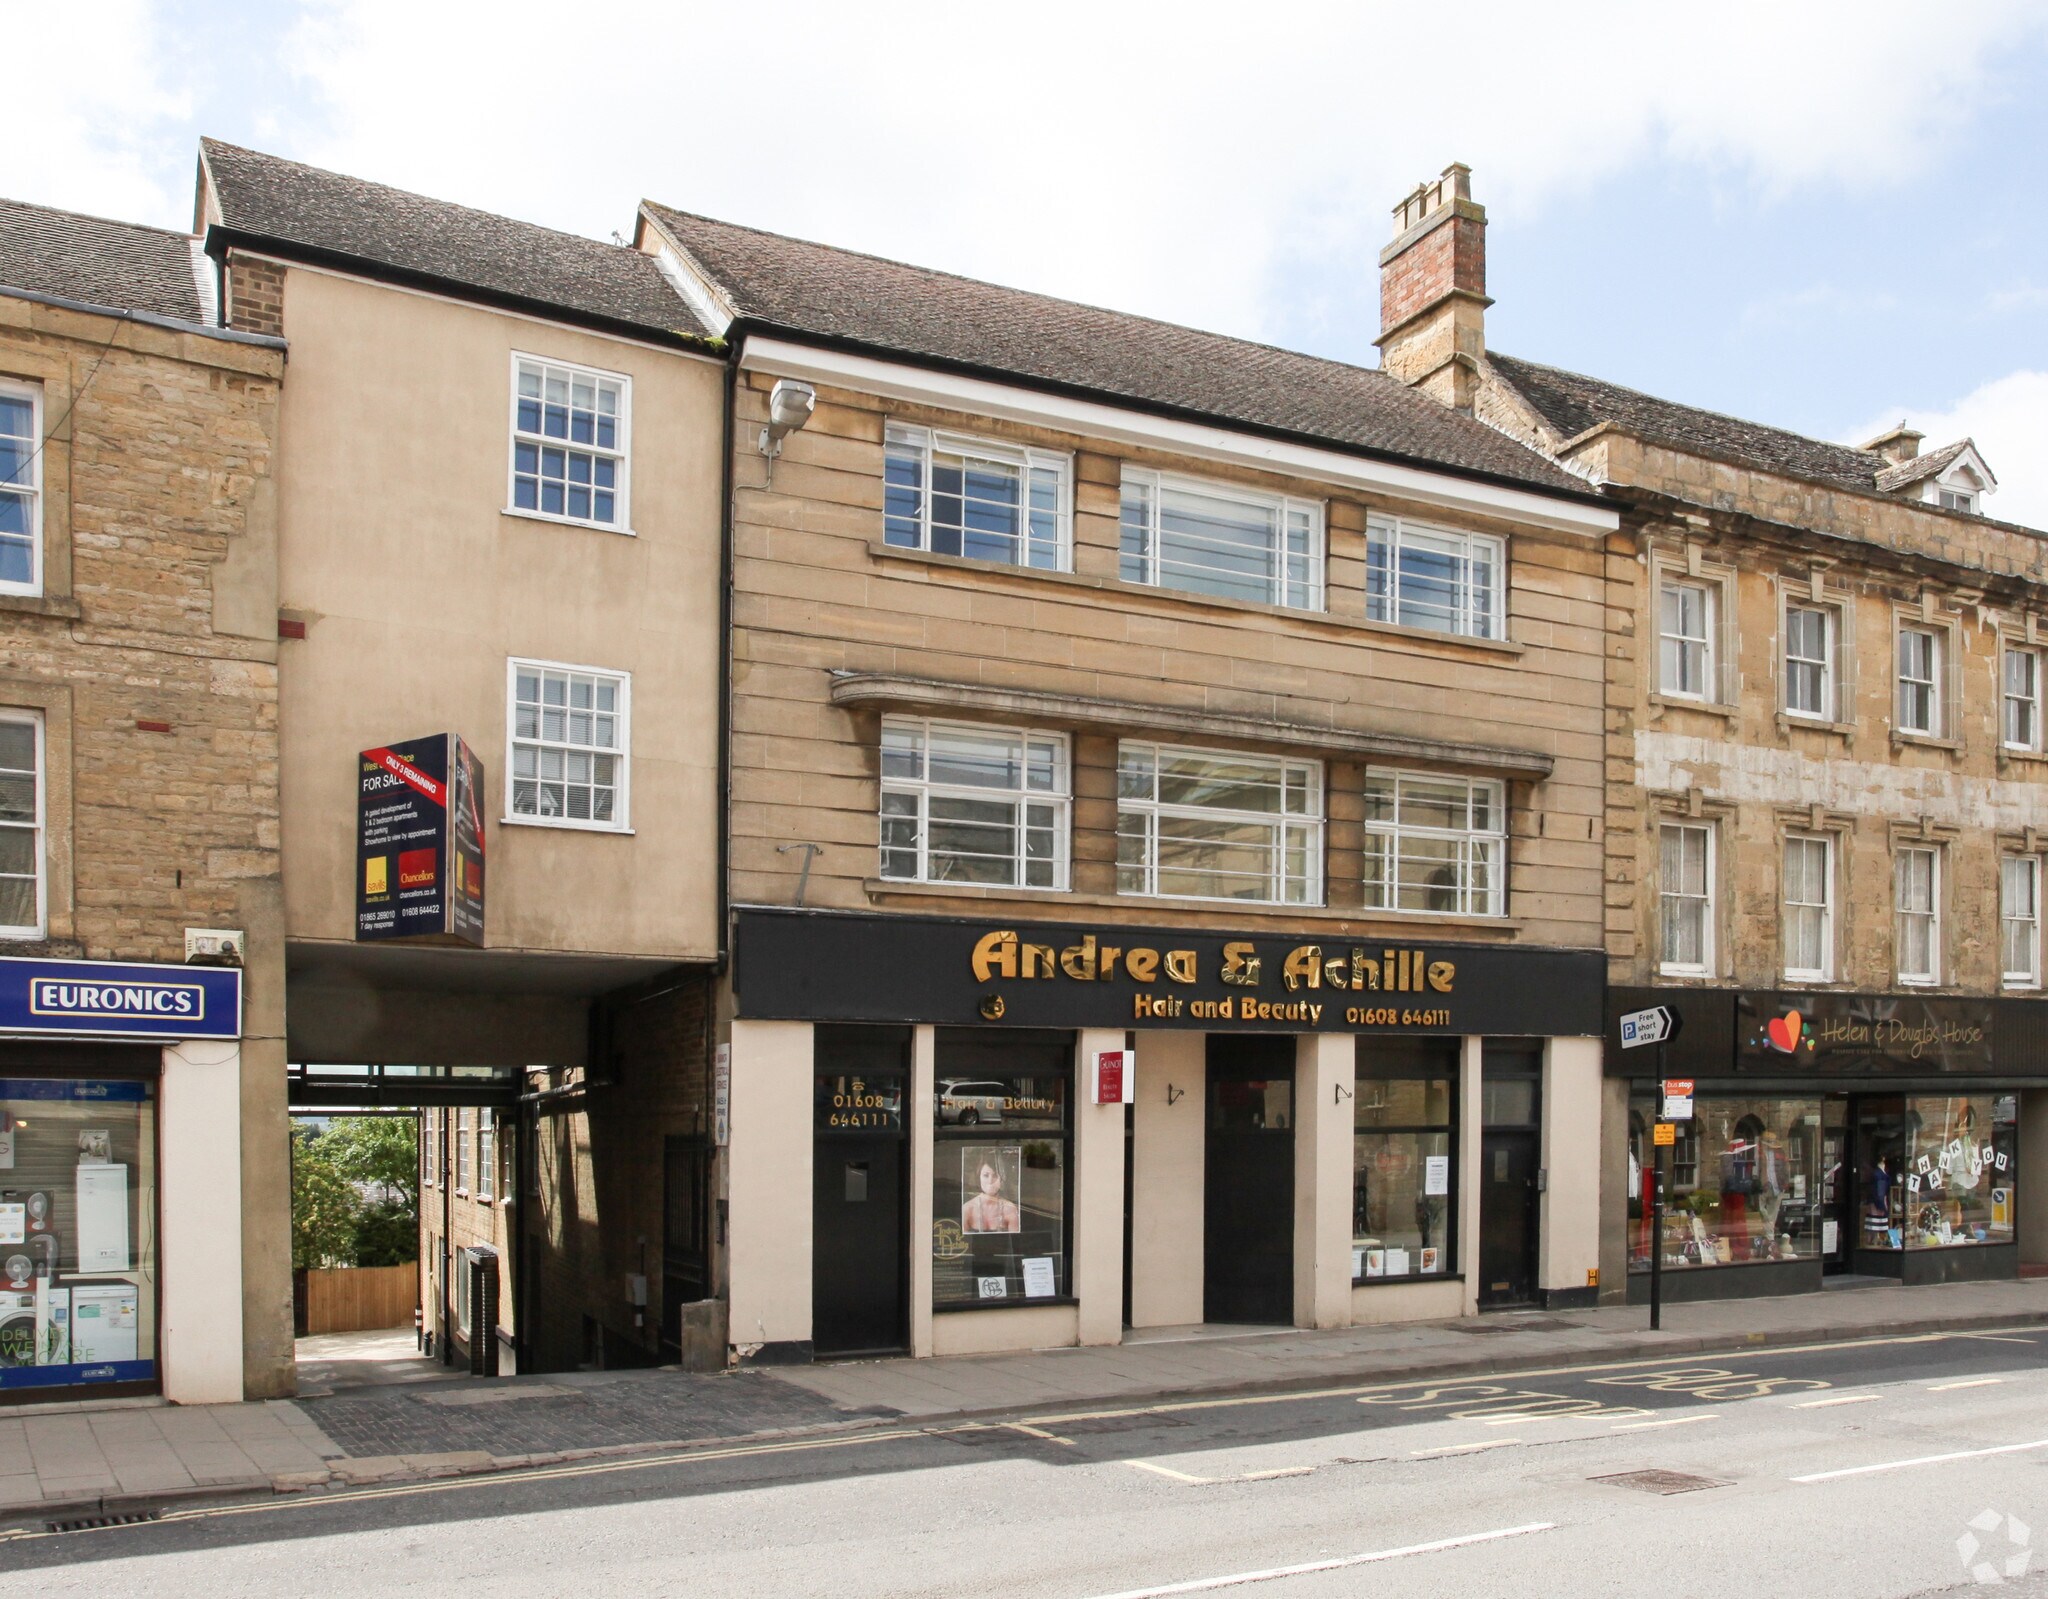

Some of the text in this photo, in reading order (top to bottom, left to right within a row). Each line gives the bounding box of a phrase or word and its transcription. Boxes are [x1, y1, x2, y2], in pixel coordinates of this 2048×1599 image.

[386, 756, 437, 794] ONLY 3 REMAINING
[363, 776, 382, 792] FOR
[381, 803, 407, 815] development
[407, 801, 413, 810] of
[376, 816, 393, 825] bedroom
[394, 811, 418, 821] apartments
[374, 827, 389, 836] parking
[402, 832, 407, 840] by
[408, 827, 437, 839] appointment
[401, 870, 434, 884] Chancellors
[367, 880, 386, 892] savills
[400, 888, 437, 899] chancellors.co.uk
[419, 905, 440, 915] 644422
[364, 922, 373, 931] day
[374, 921, 394, 930] response
[972, 930, 1456, 993] Andrea & Achille
[42, 985, 192, 1013] EURONICS
[1134, 993, 1450, 1026] Hair and Beauty 01608 646111
[1638, 1014, 1654, 1022] Free
[1638, 1022, 1656, 1032] short
[1640, 1033, 1655, 1041] stay
[1821, 1016, 1983, 1059] Helen & Douglas House
[1678, 1081, 1693, 1089] stop
[833, 1094, 884, 1108] 01608
[945, 1096, 1055, 1113] Hair & Beauty
[830, 1113, 887, 1126] 646111
[1974, 1151, 2005, 1171] YOU
[2, 1327, 67, 1342] DELIVER
[3, 1341, 35, 1356] WE
[38, 1348, 96, 1365] CARE
[1584, 1368, 1832, 1401] BUS
[1356, 1386, 1657, 1426] STOP
